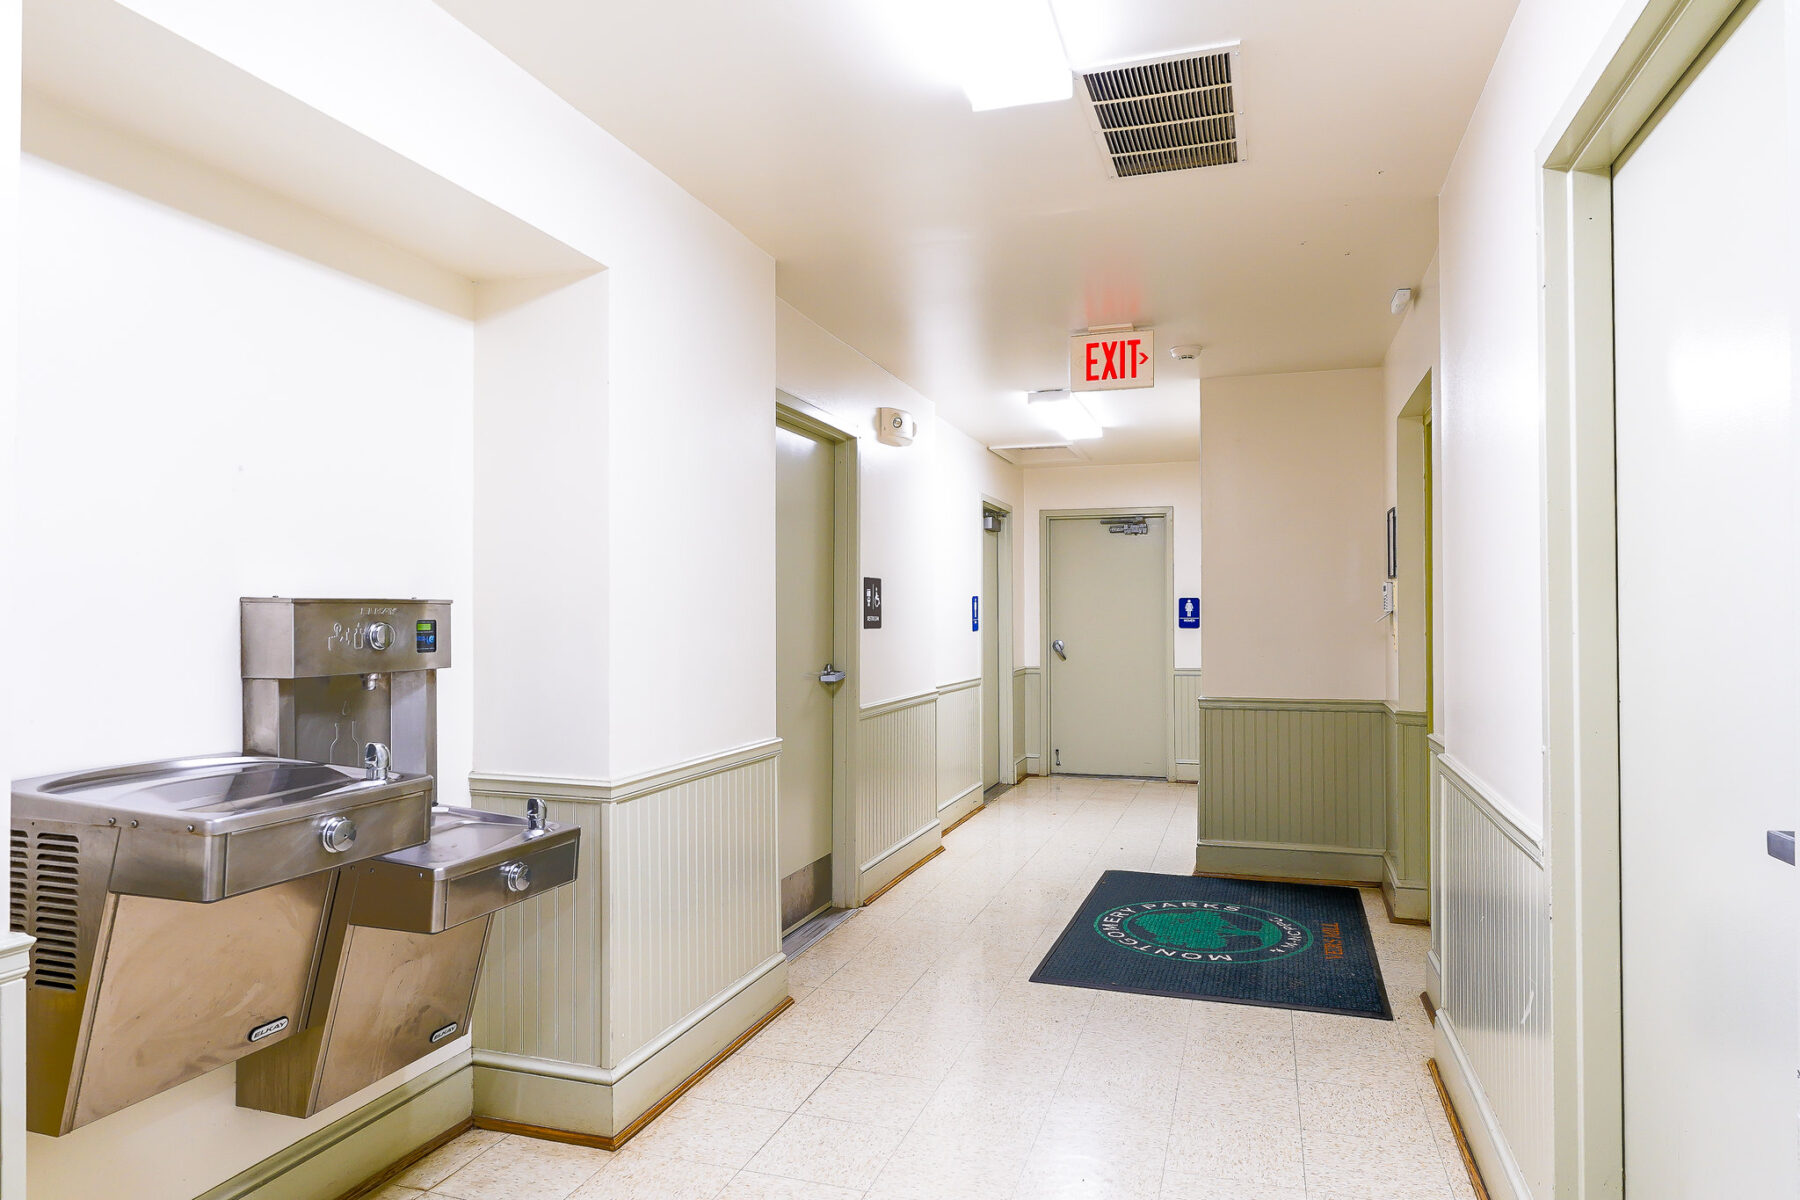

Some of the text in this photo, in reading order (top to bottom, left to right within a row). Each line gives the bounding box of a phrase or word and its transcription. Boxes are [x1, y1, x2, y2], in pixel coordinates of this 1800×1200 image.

[1086, 339, 1141, 381] EXIT
[1102, 902, 1240, 962] MONTGOMERY PARKS
[253, 1020, 287, 1039] ELKAY
